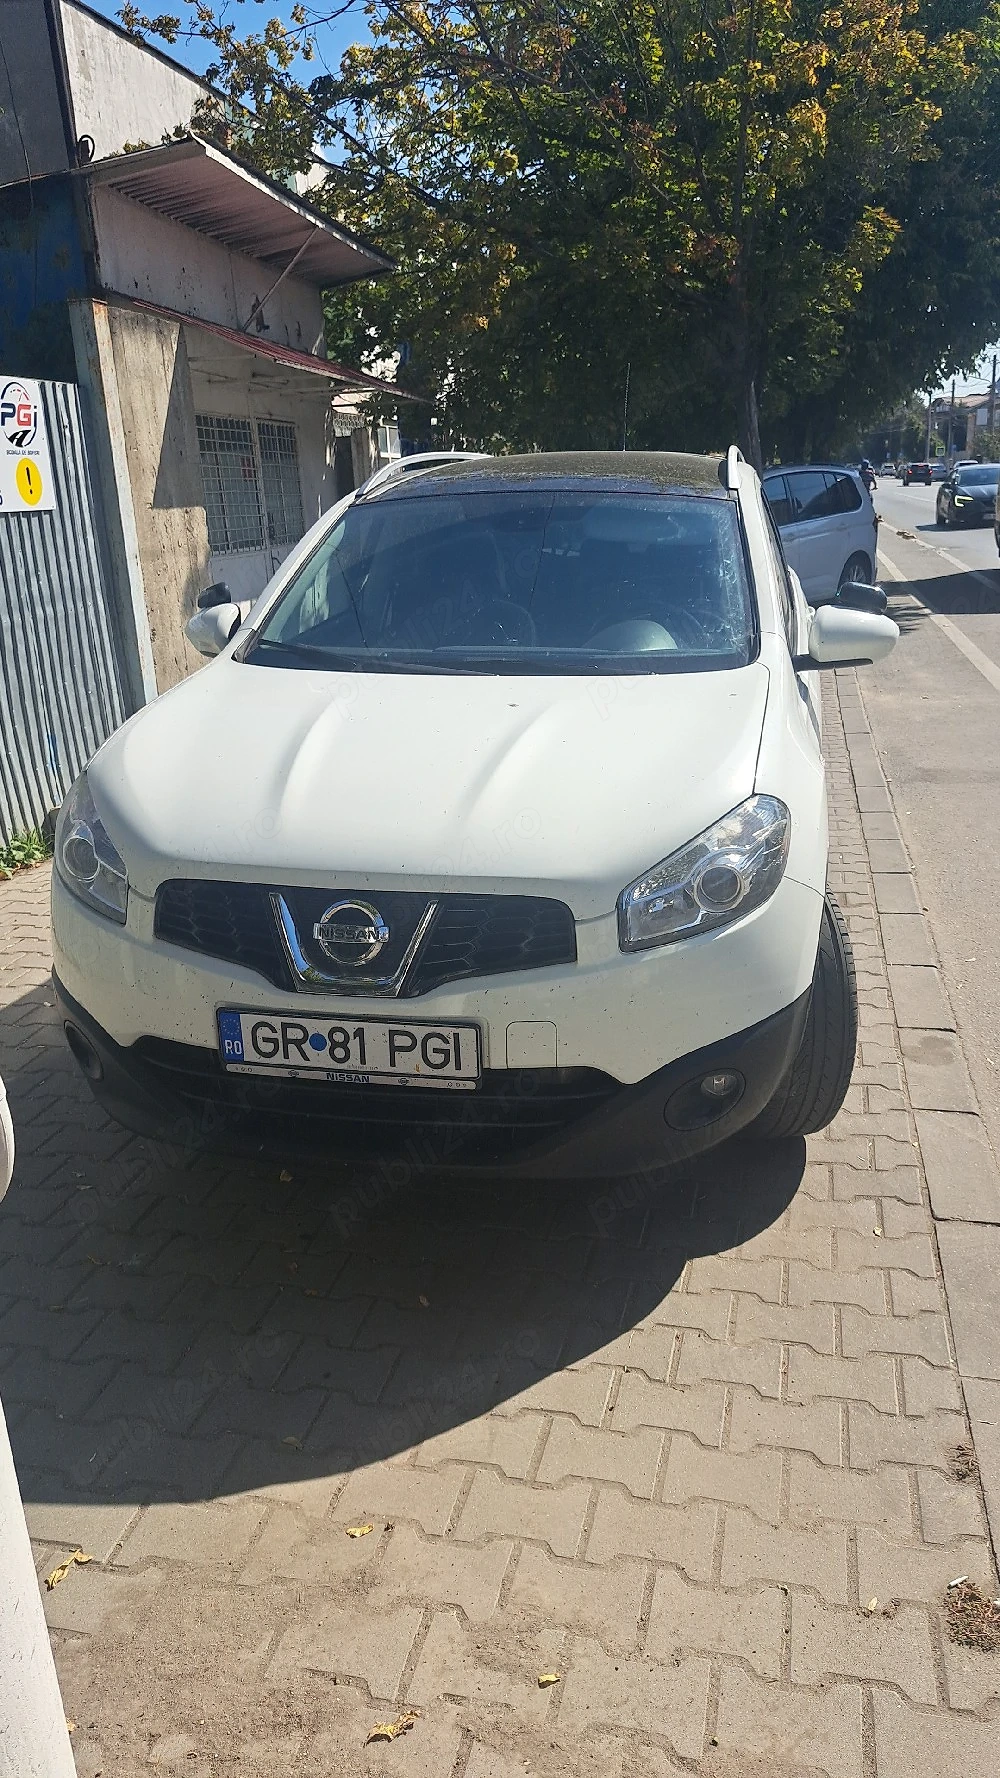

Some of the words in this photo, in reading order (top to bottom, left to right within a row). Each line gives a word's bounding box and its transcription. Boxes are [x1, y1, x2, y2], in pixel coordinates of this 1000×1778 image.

[320, 924, 379, 942] NISSAN
[224, 1038, 242, 1055] RO
[251, 1020, 310, 1062] GR
[327, 1026, 367, 1065] 81
[388, 1029, 462, 1071] PGI
